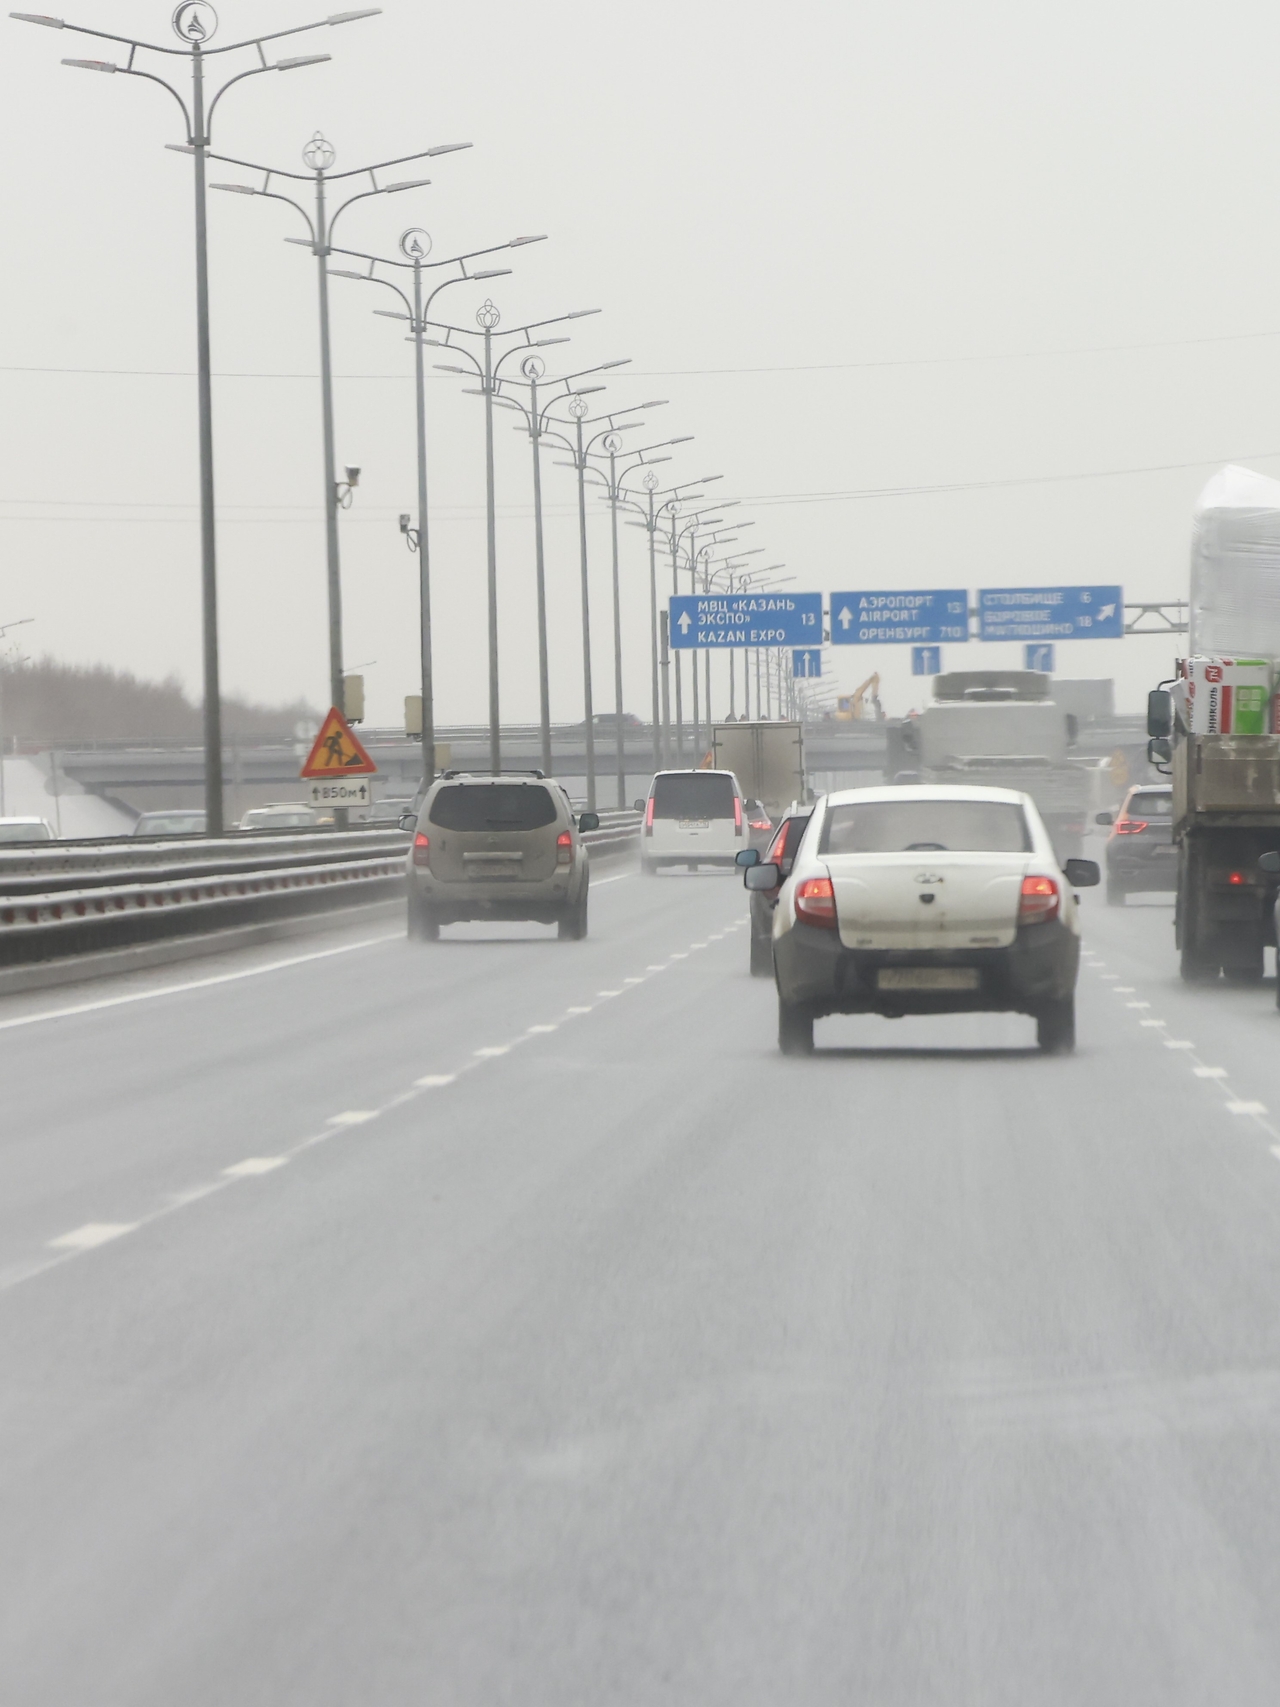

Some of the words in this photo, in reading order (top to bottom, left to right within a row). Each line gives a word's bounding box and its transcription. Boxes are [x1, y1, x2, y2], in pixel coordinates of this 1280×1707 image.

[698, 600, 728, 614] МВЦ
[732, 599, 796, 612] «КАЗАНЬ
[859, 596, 932, 609] АЭРОПОРТ
[698, 612, 751, 625] ЭКСПО»
[801, 613, 815, 625] 13
[859, 610, 918, 622] AIRPORT
[698, 631, 745, 643] KAZAN
[750, 629, 785, 642] EXPO
[859, 627, 930, 640] ОРЕНБУРГ
